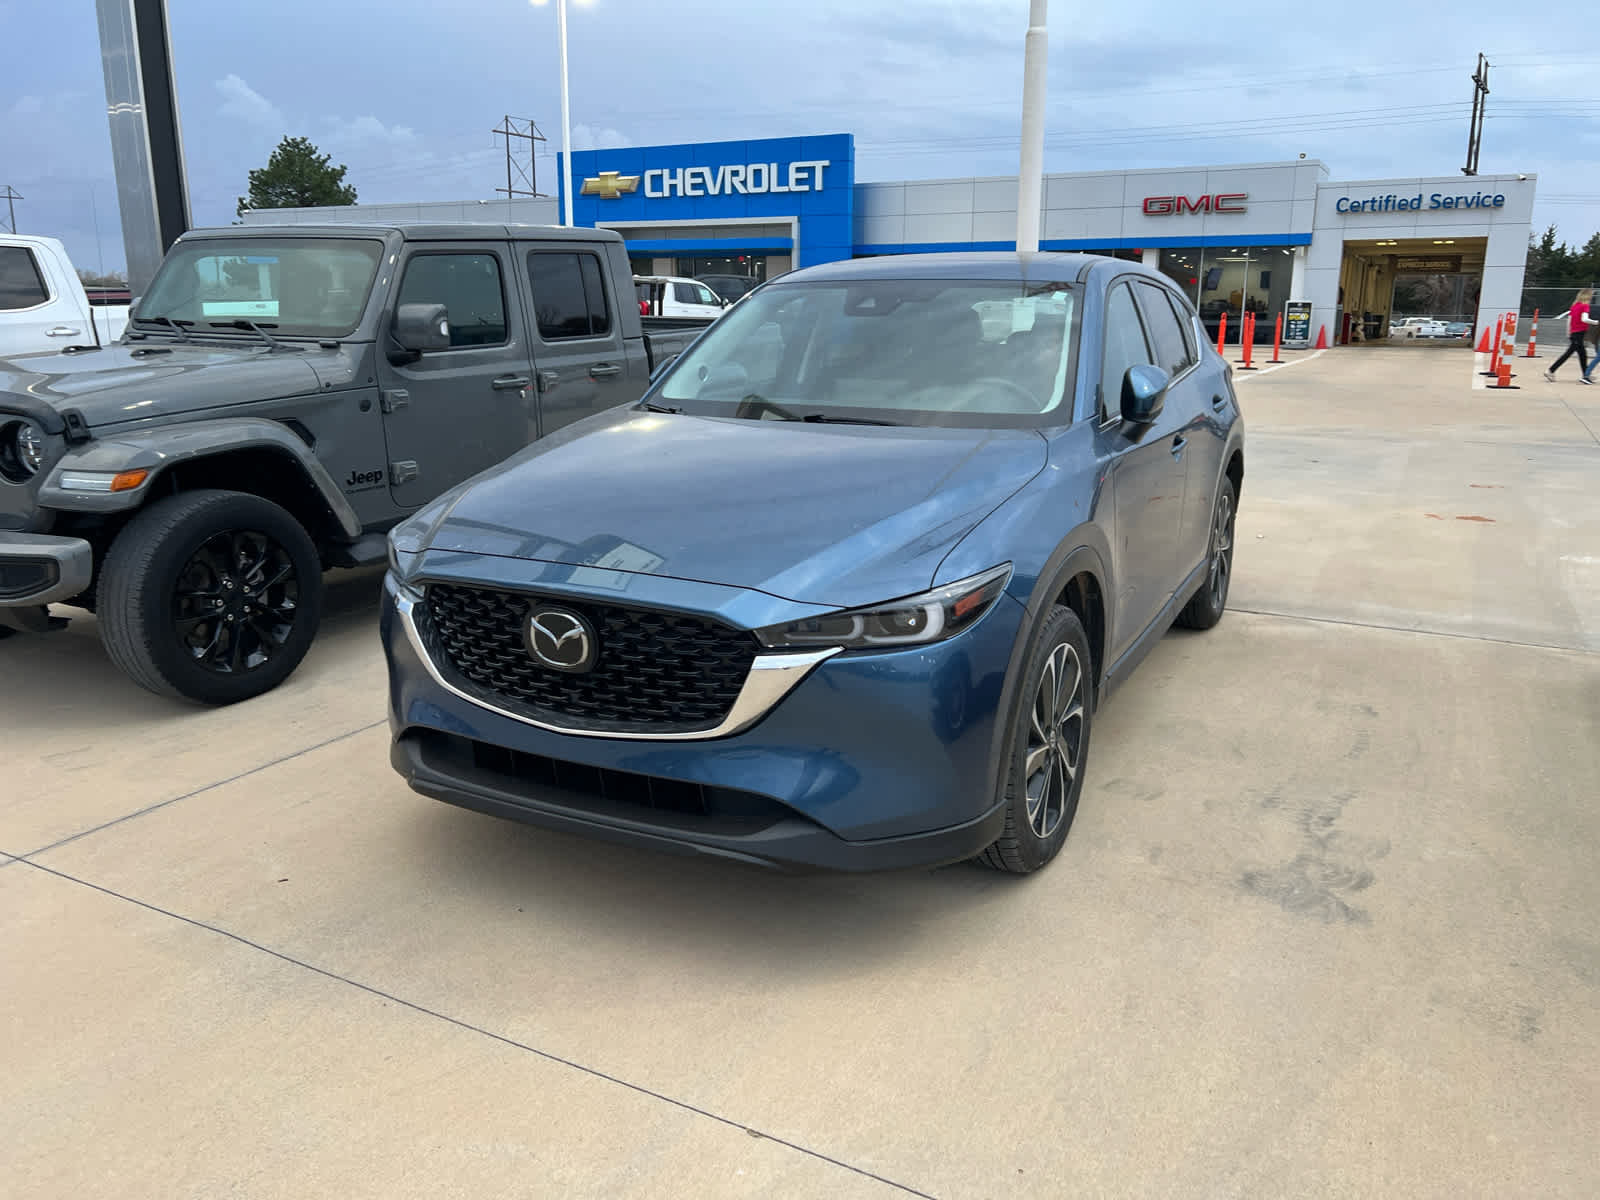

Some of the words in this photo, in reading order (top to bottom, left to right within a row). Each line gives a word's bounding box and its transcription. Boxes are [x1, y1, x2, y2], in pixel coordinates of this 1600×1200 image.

[644, 160, 831, 198] CHEVROLET
[1143, 193, 1248, 215] GMC
[1336, 194, 1423, 213] Certified
[1429, 191, 1505, 210] Service
[346, 470, 383, 486] Jeep
